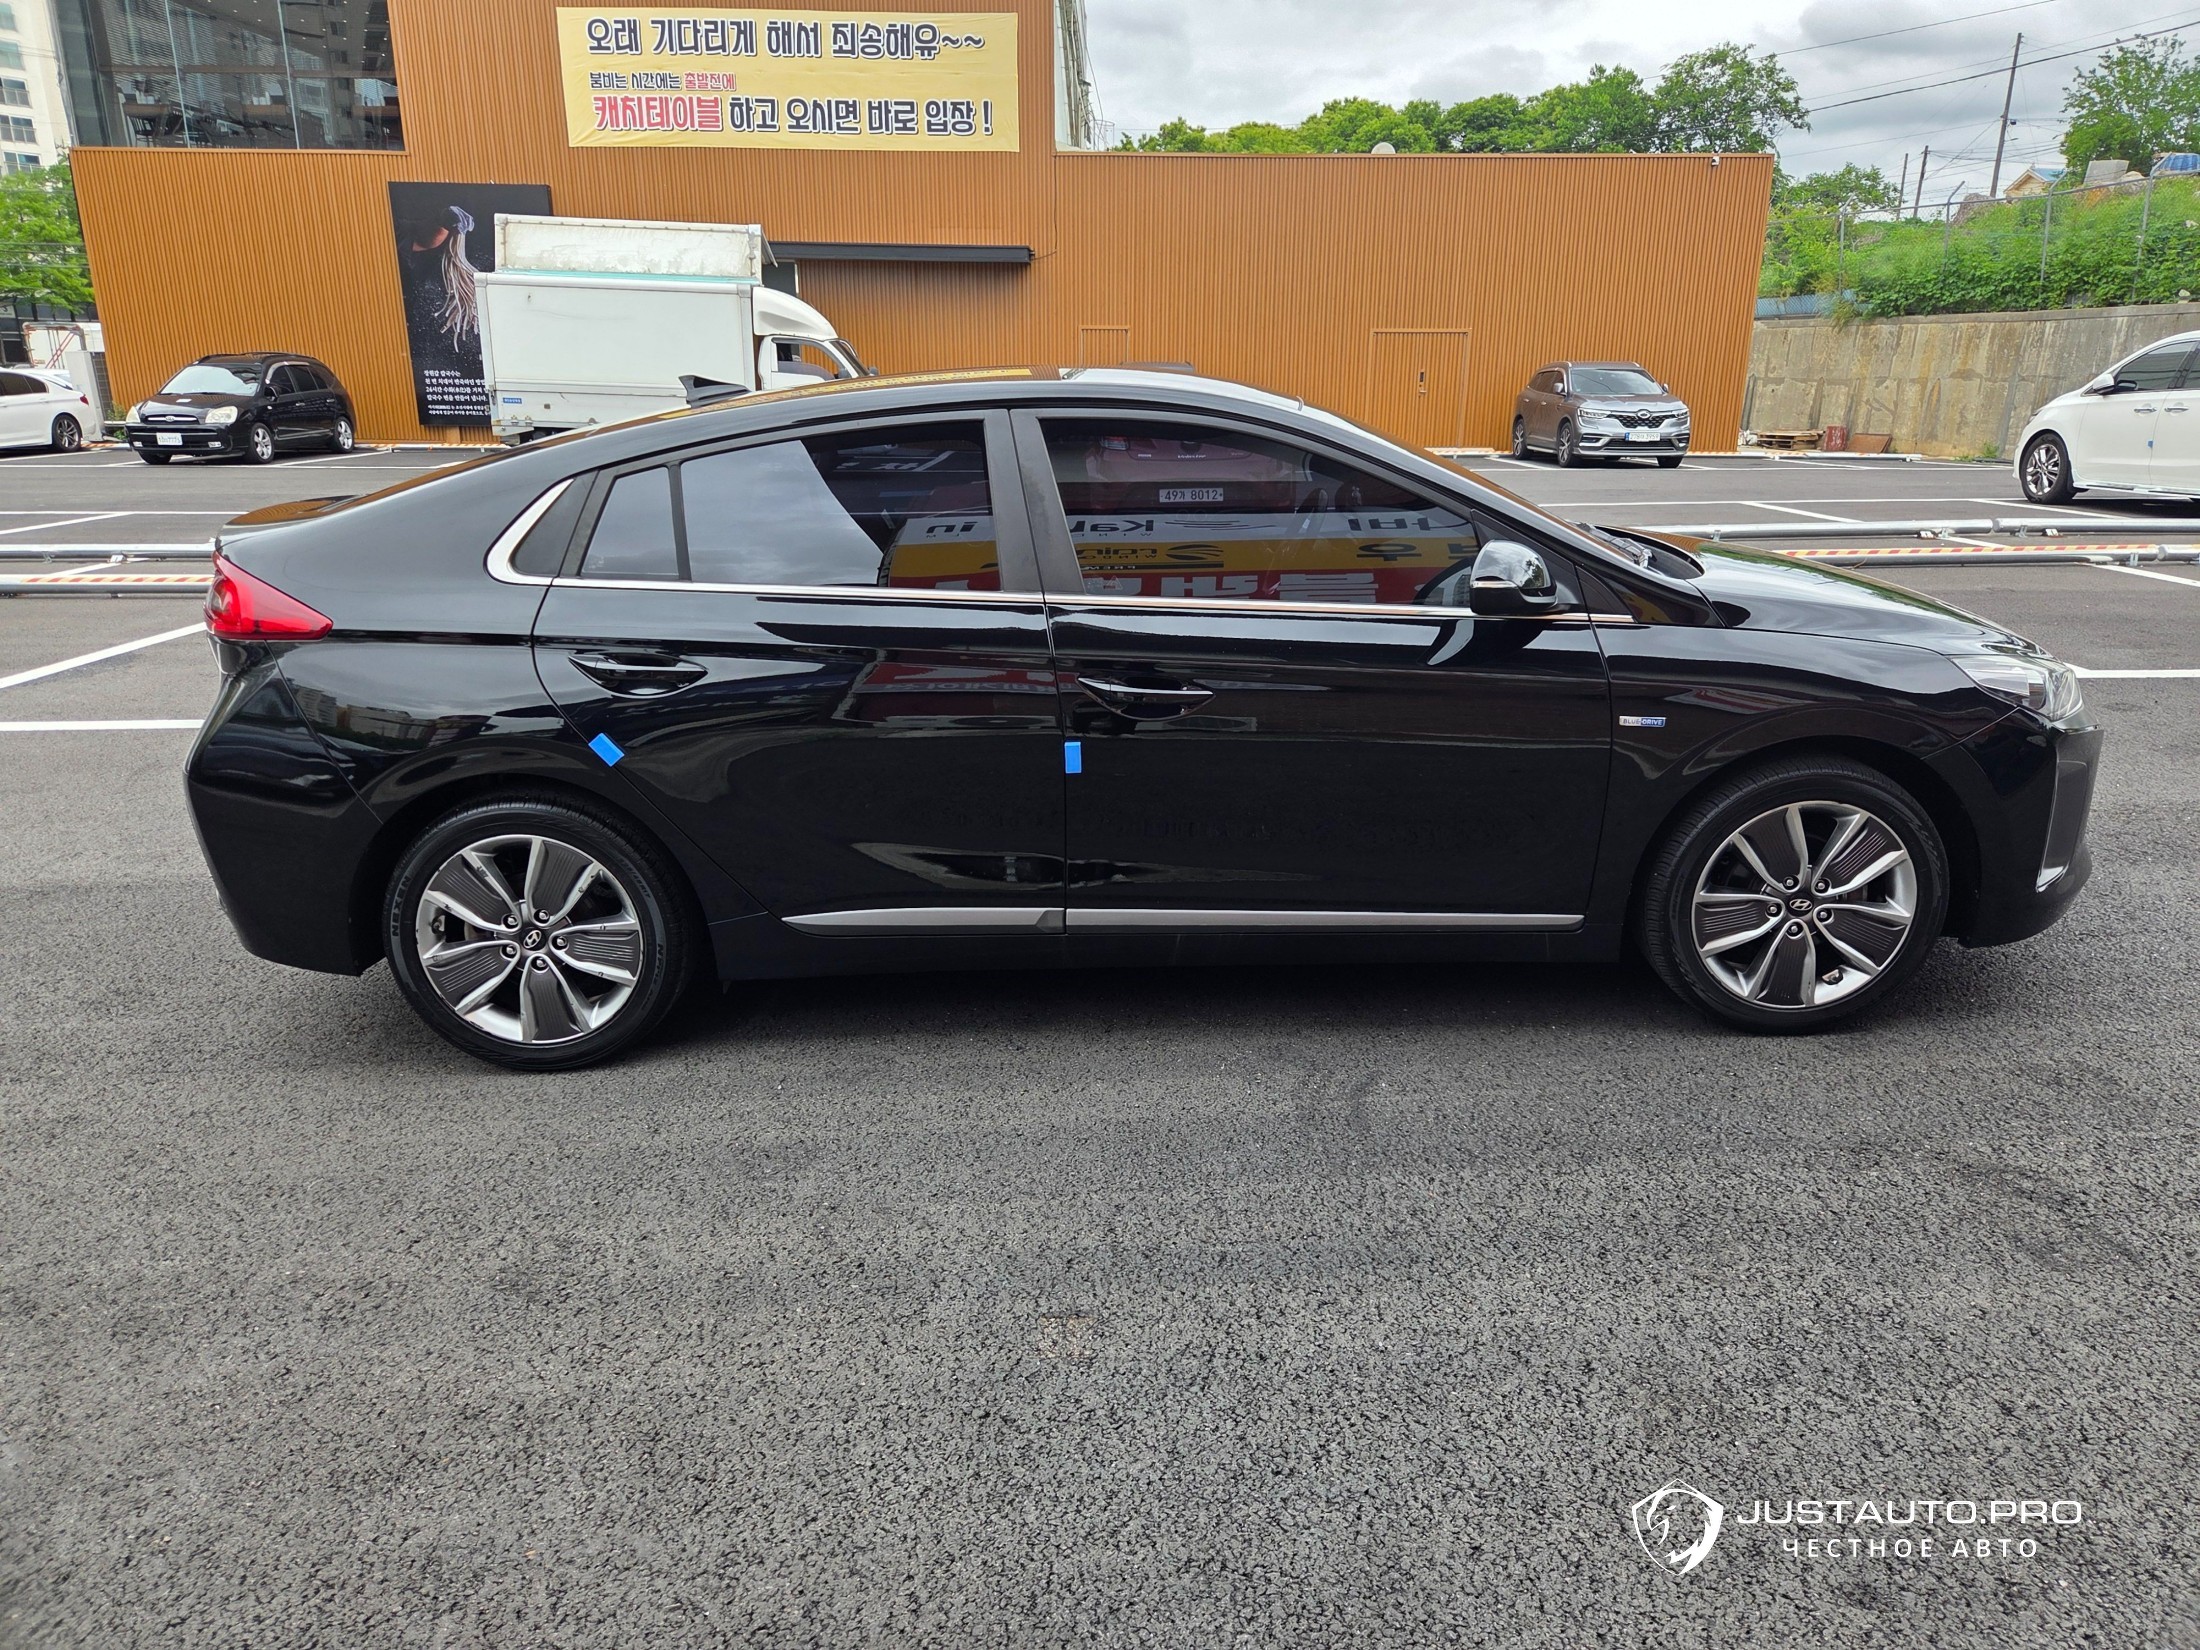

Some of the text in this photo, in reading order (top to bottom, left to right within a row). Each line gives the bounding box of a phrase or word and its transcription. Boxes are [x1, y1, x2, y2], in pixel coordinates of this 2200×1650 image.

[586, 17, 984, 59] 오래 기다리게 해서 죄송해유~~
[589, 71, 736, 91] 붐비는 시간에는 출발전에
[592, 95, 722, 131] 캐치테이블
[729, 95, 780, 131] 하고
[786, 97, 861, 134] 오시면
[867, 99, 918, 133] 바로
[925, 100, 976, 135] 입장
[1191, 489, 1219, 501] 8012
